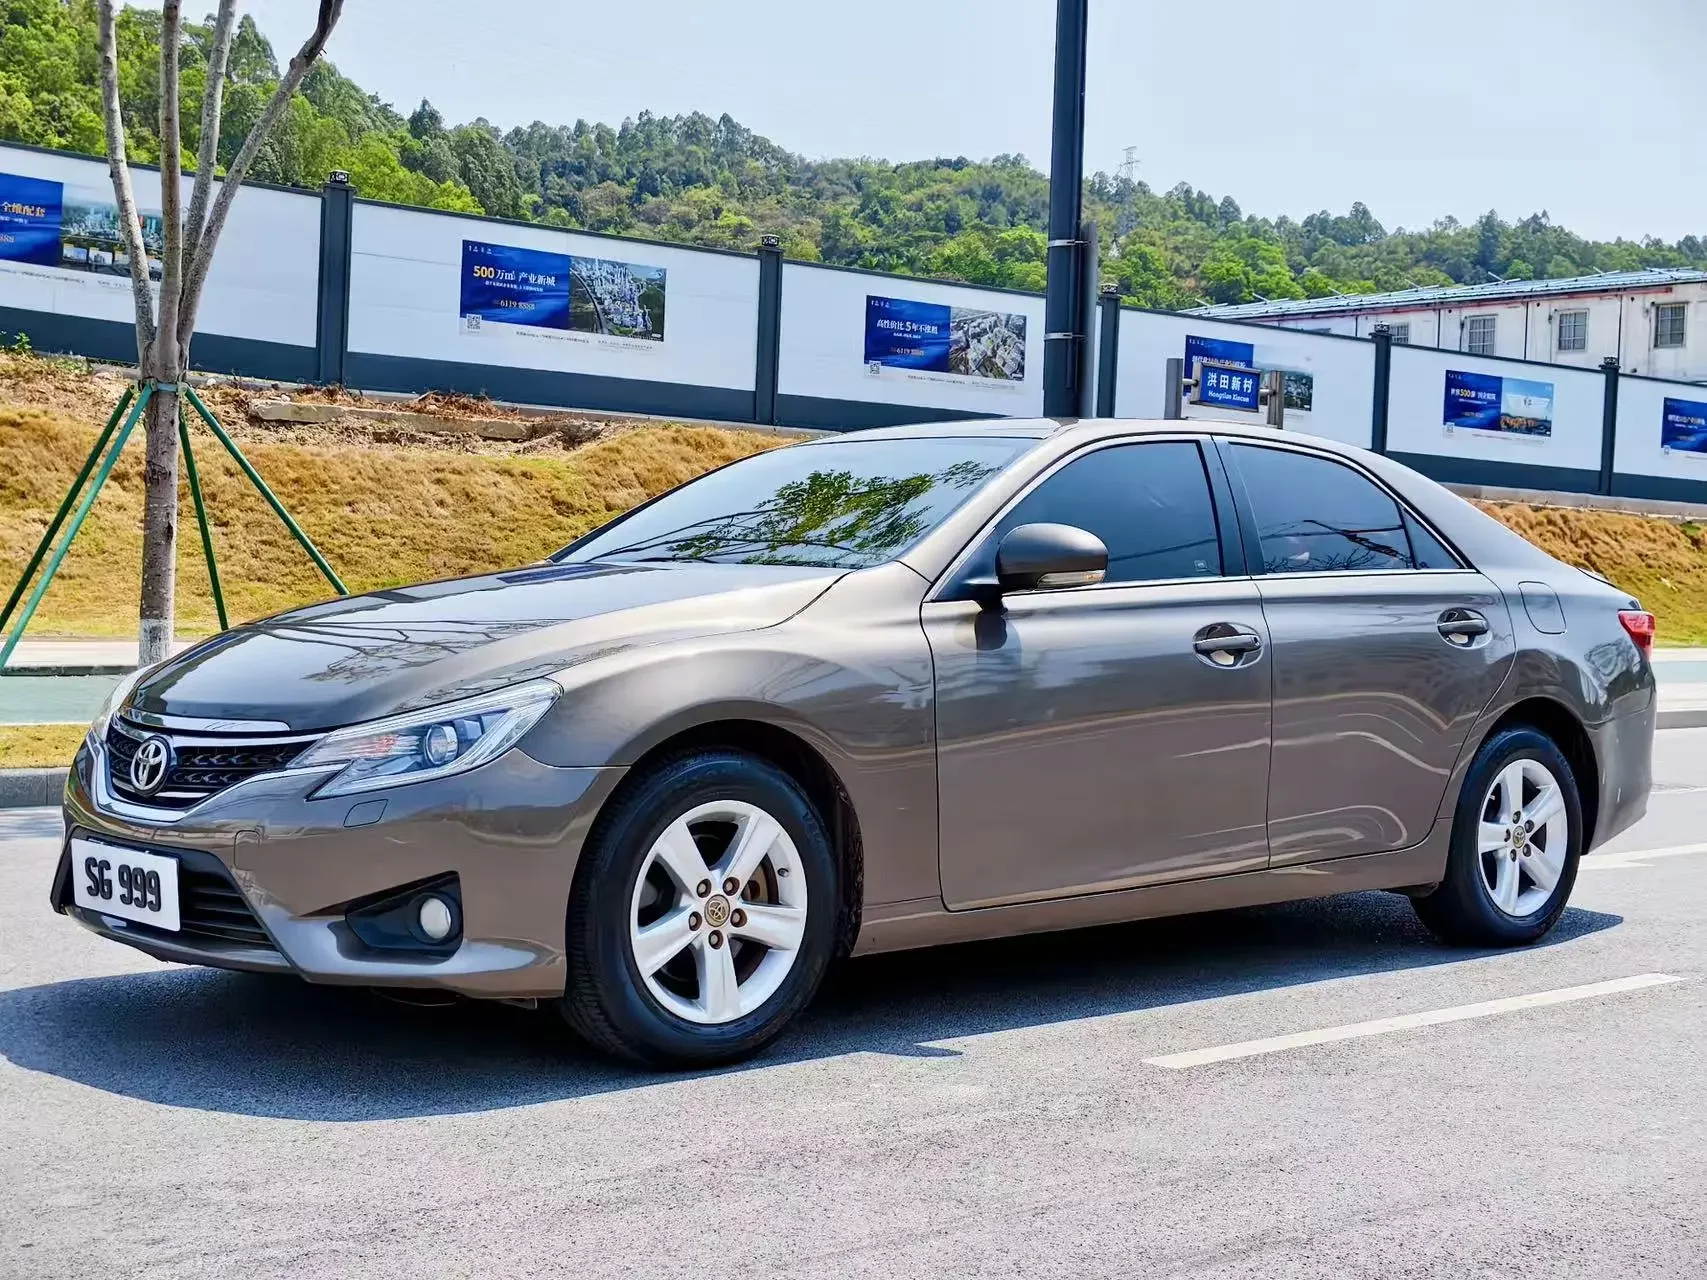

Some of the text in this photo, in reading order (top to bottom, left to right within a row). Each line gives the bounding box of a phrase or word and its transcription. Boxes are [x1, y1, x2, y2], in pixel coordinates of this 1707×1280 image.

[518, 271, 556, 287] 产业新城
[1207, 372, 1253, 393] 洪田新村
[1208, 390, 1250, 402] Hongtian Xincun
[85, 857, 161, 912] SG 999
